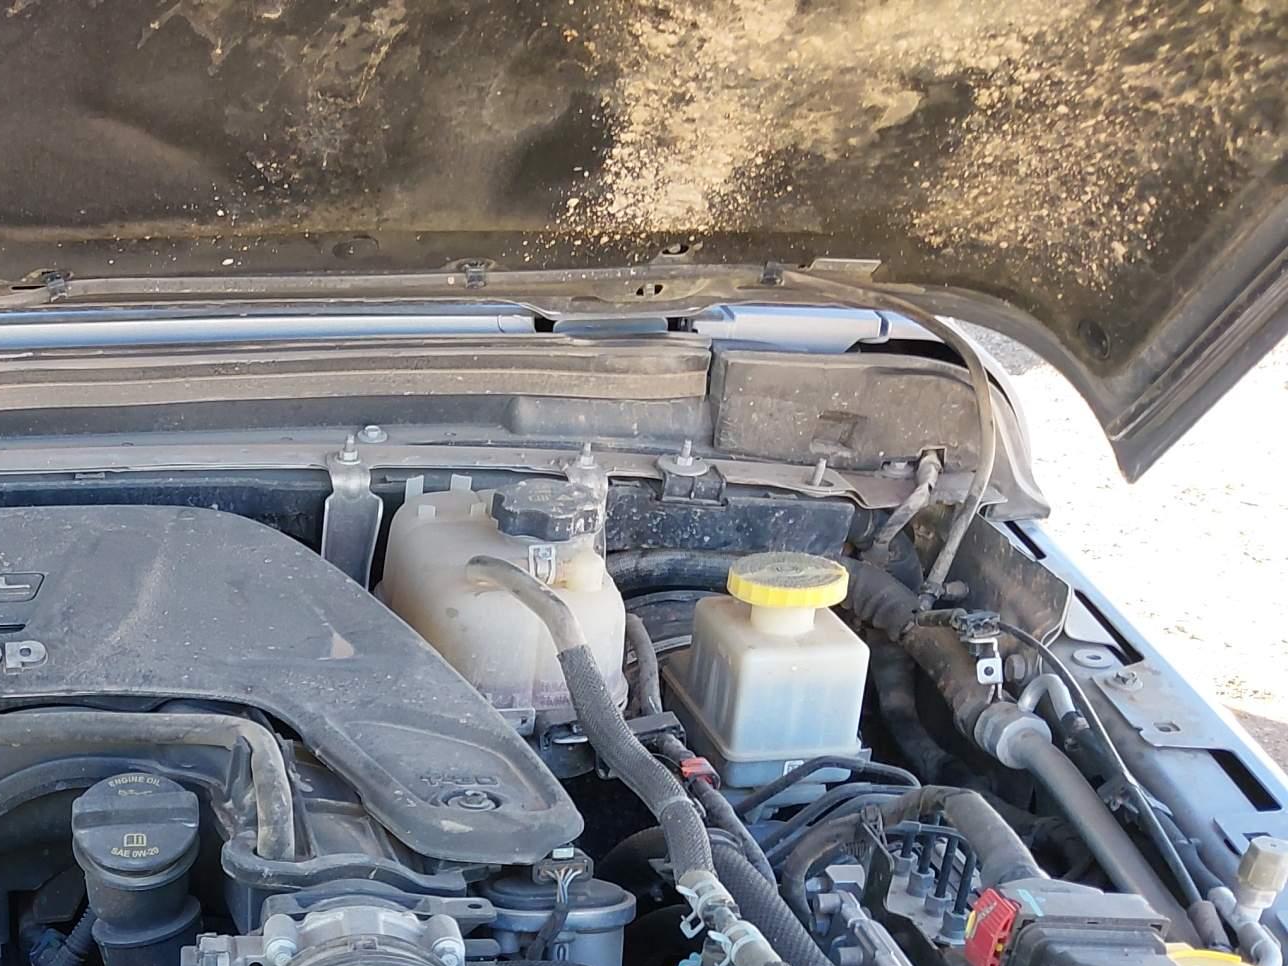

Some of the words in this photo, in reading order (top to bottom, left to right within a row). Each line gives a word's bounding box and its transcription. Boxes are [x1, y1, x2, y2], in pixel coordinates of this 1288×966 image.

[108, 775, 144, 787] ENGINE
[146, 776, 161, 787] OIL
[110, 847, 130, 857] SAE
[132, 847, 160, 858] 0W-20
